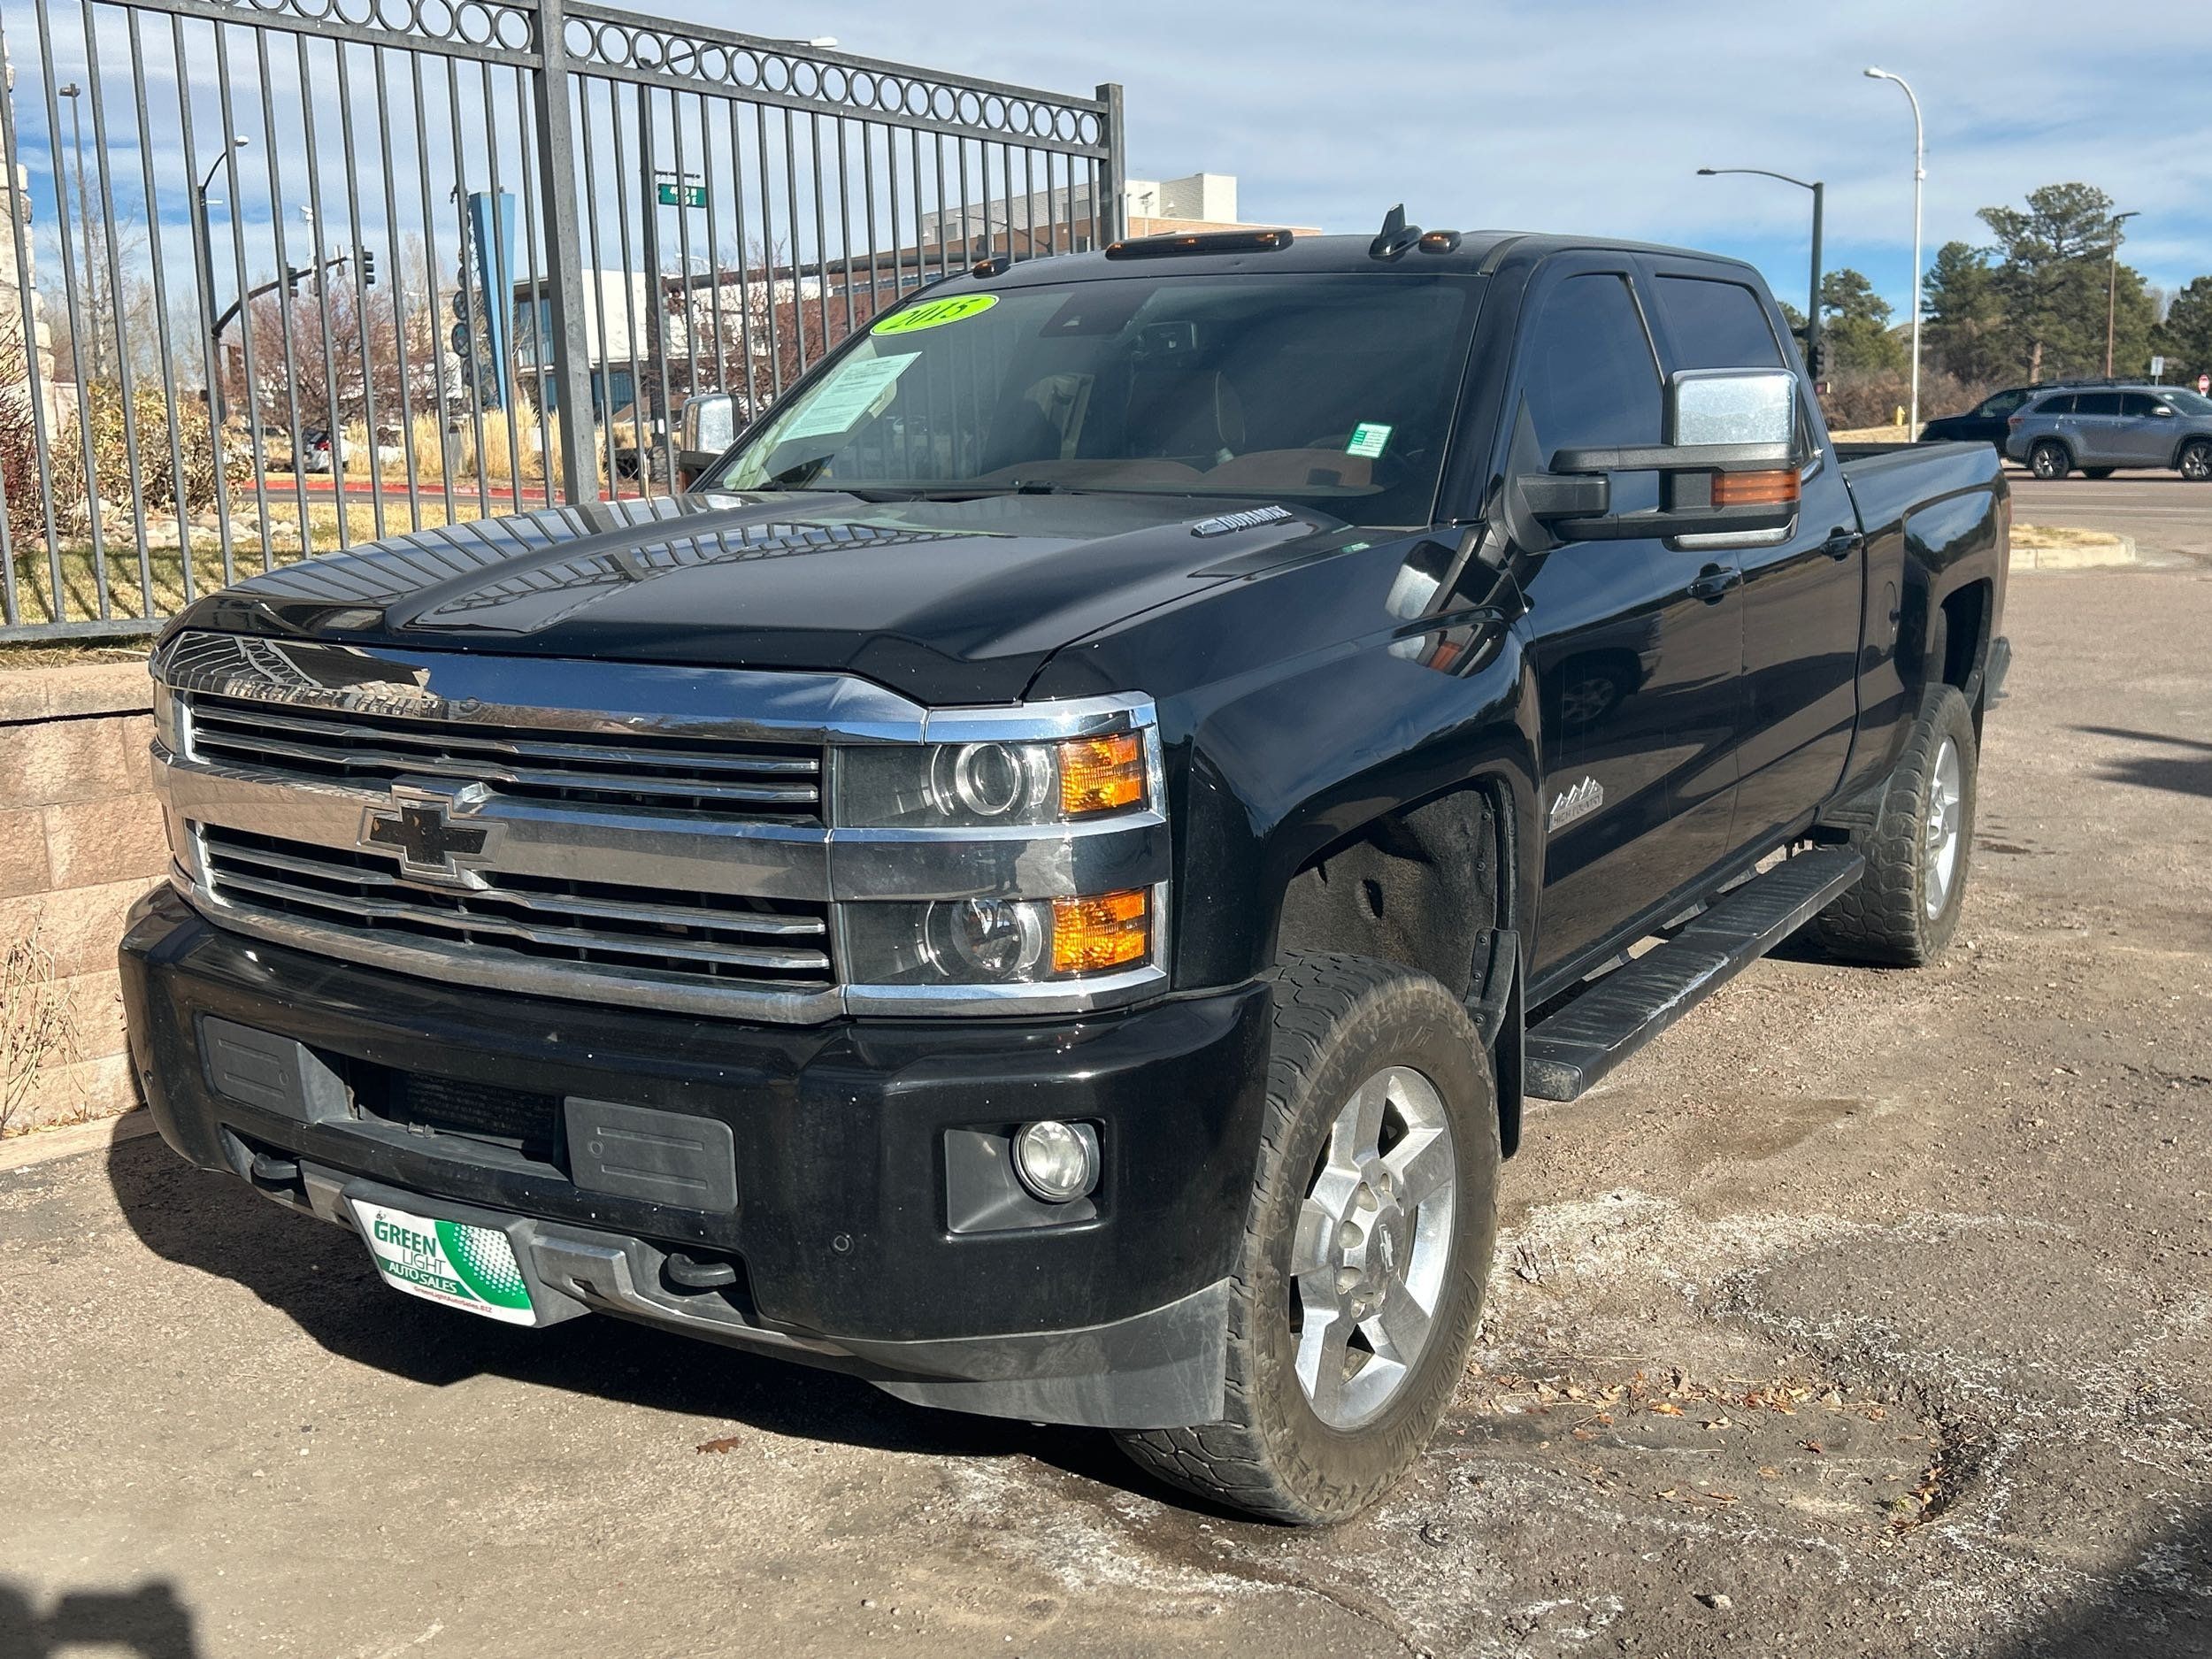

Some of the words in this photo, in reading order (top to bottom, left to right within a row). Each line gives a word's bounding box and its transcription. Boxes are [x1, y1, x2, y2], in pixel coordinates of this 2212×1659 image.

[884, 298, 981, 331] 2015
[1216, 505, 1293, 529] DURAMAX
[374, 1220, 436, 1257] GREEN
[403, 1248, 446, 1274] LIGHT
[388, 1262, 419, 1280] AUTO
[419, 1273, 457, 1294] SALES
